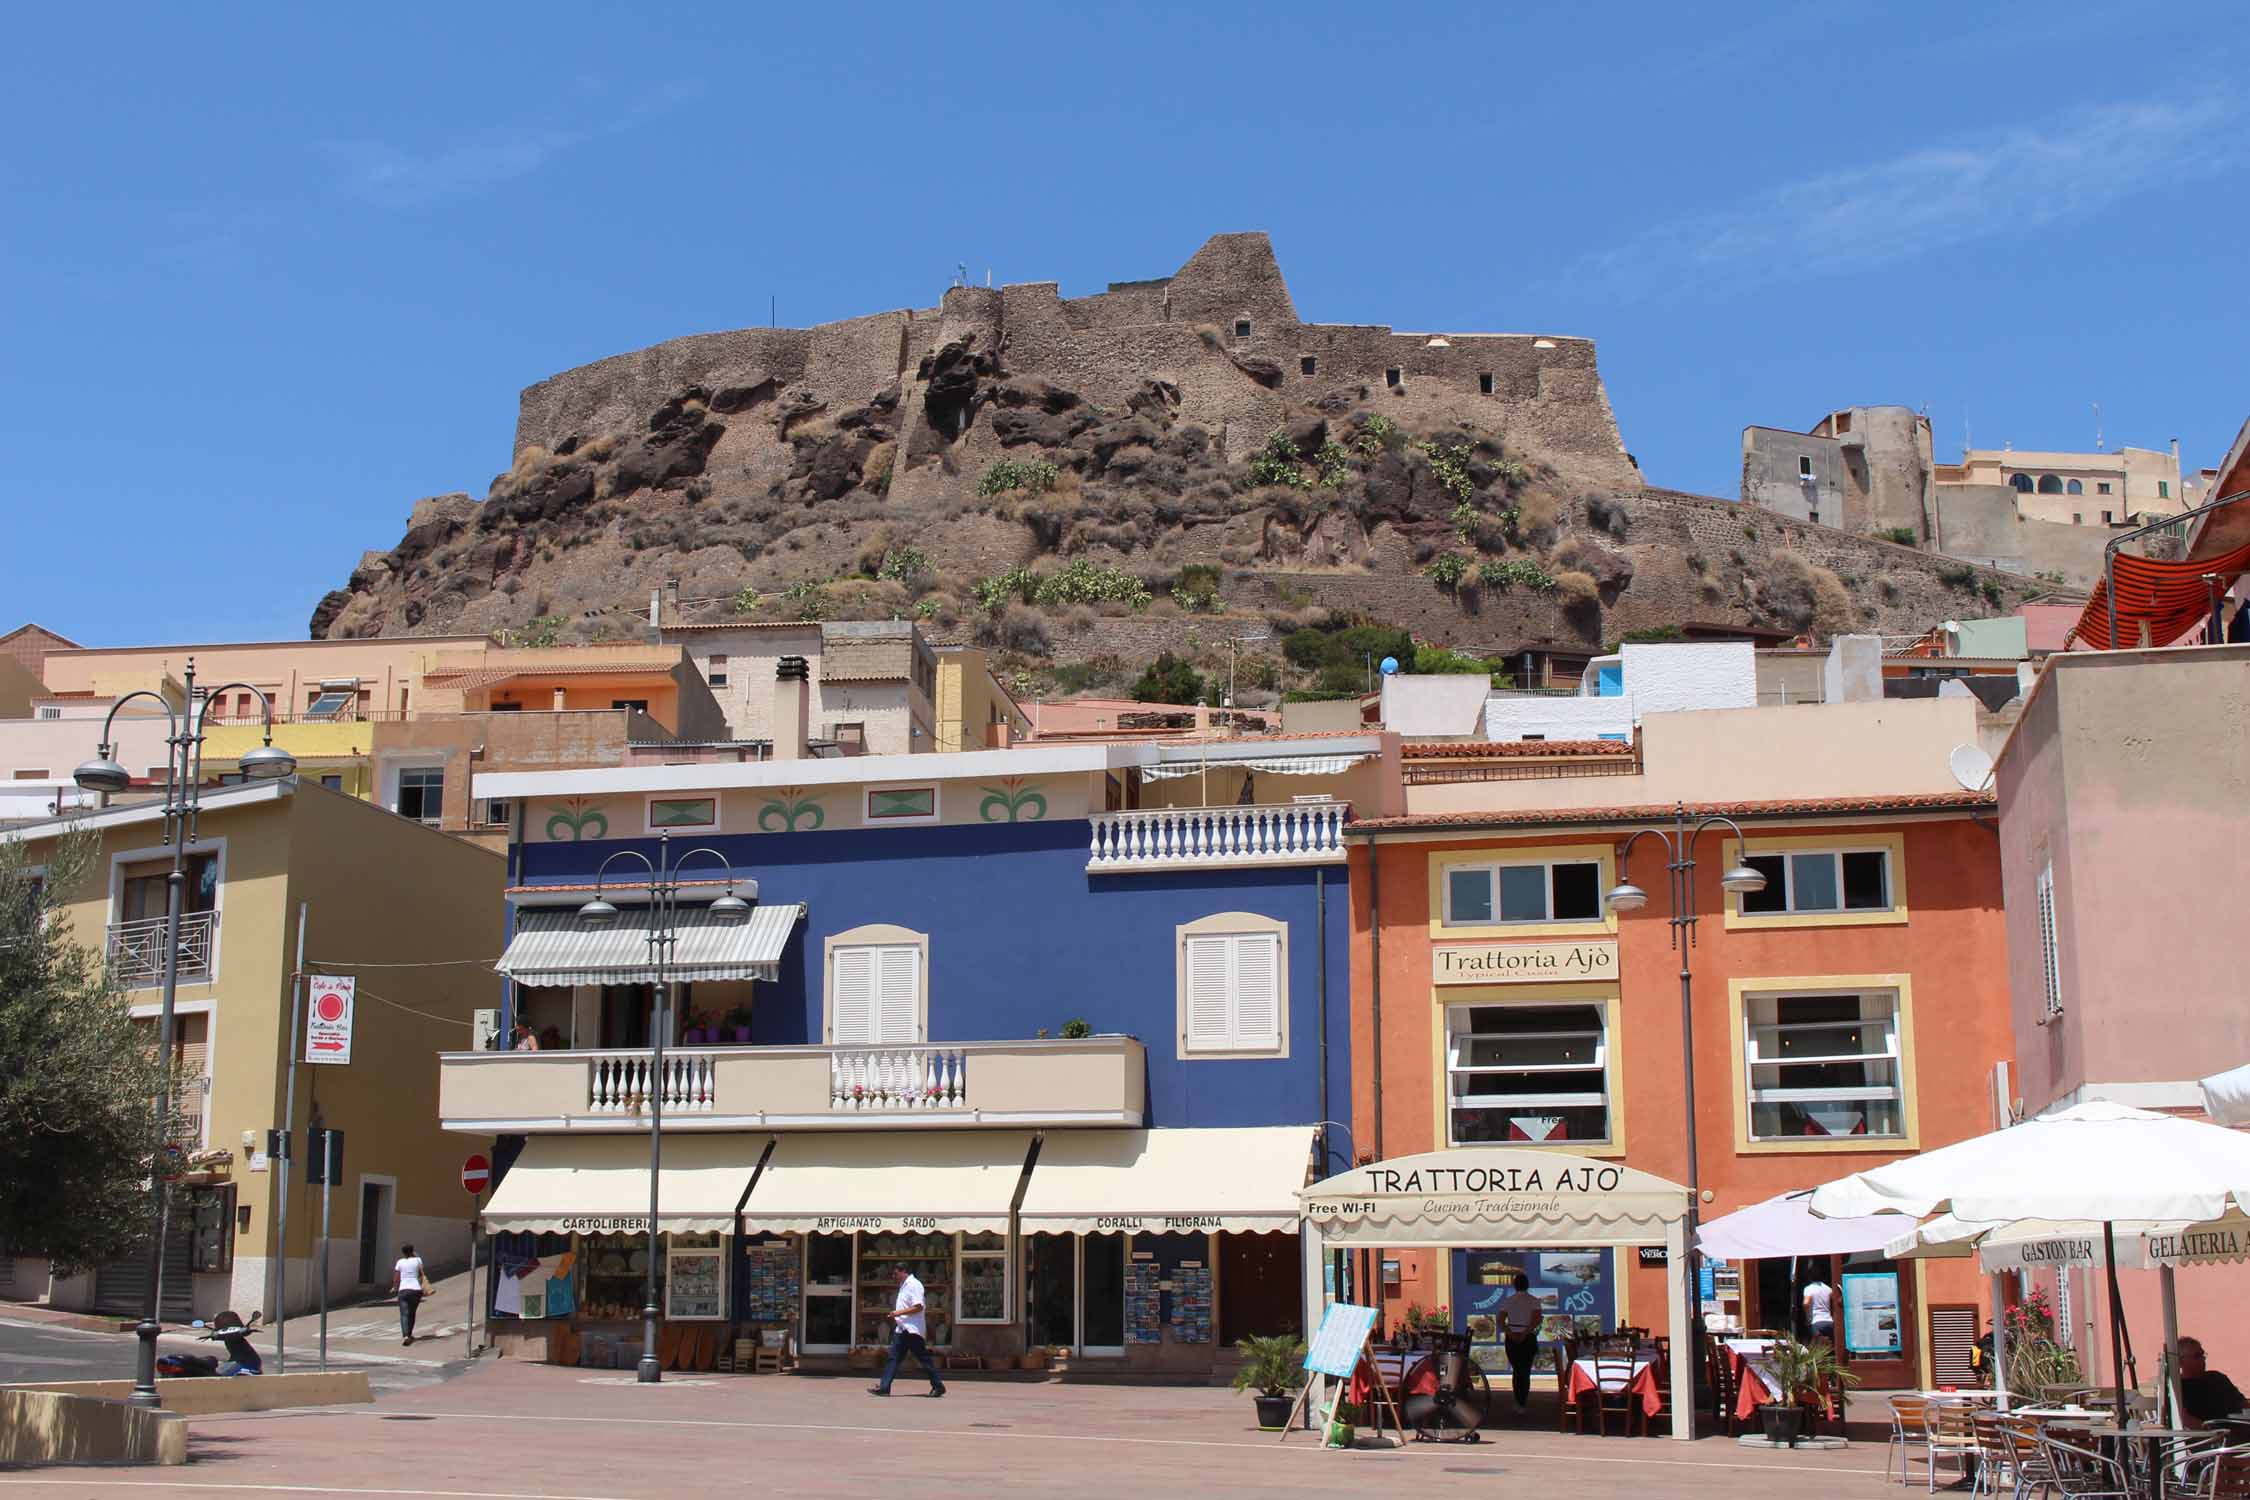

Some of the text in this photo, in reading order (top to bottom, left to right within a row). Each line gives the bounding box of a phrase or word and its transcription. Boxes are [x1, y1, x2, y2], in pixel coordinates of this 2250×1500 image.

[1438, 947, 1610, 974] Trattoria Ajò
[1366, 1167, 1624, 1193] TRATTORIA AJO'
[1309, 1202, 1376, 1213] Free WI-FI
[1423, 1195, 1560, 1214] Cucina Tradizionale
[817, 1217, 936, 1229] ARTIGIANATO SARDO
[1097, 1216, 1223, 1229] CORALLI FILIGRANA
[2021, 1239, 2093, 1262] GASTON BAR
[2149, 1231, 2240, 1258] GELATERIA
